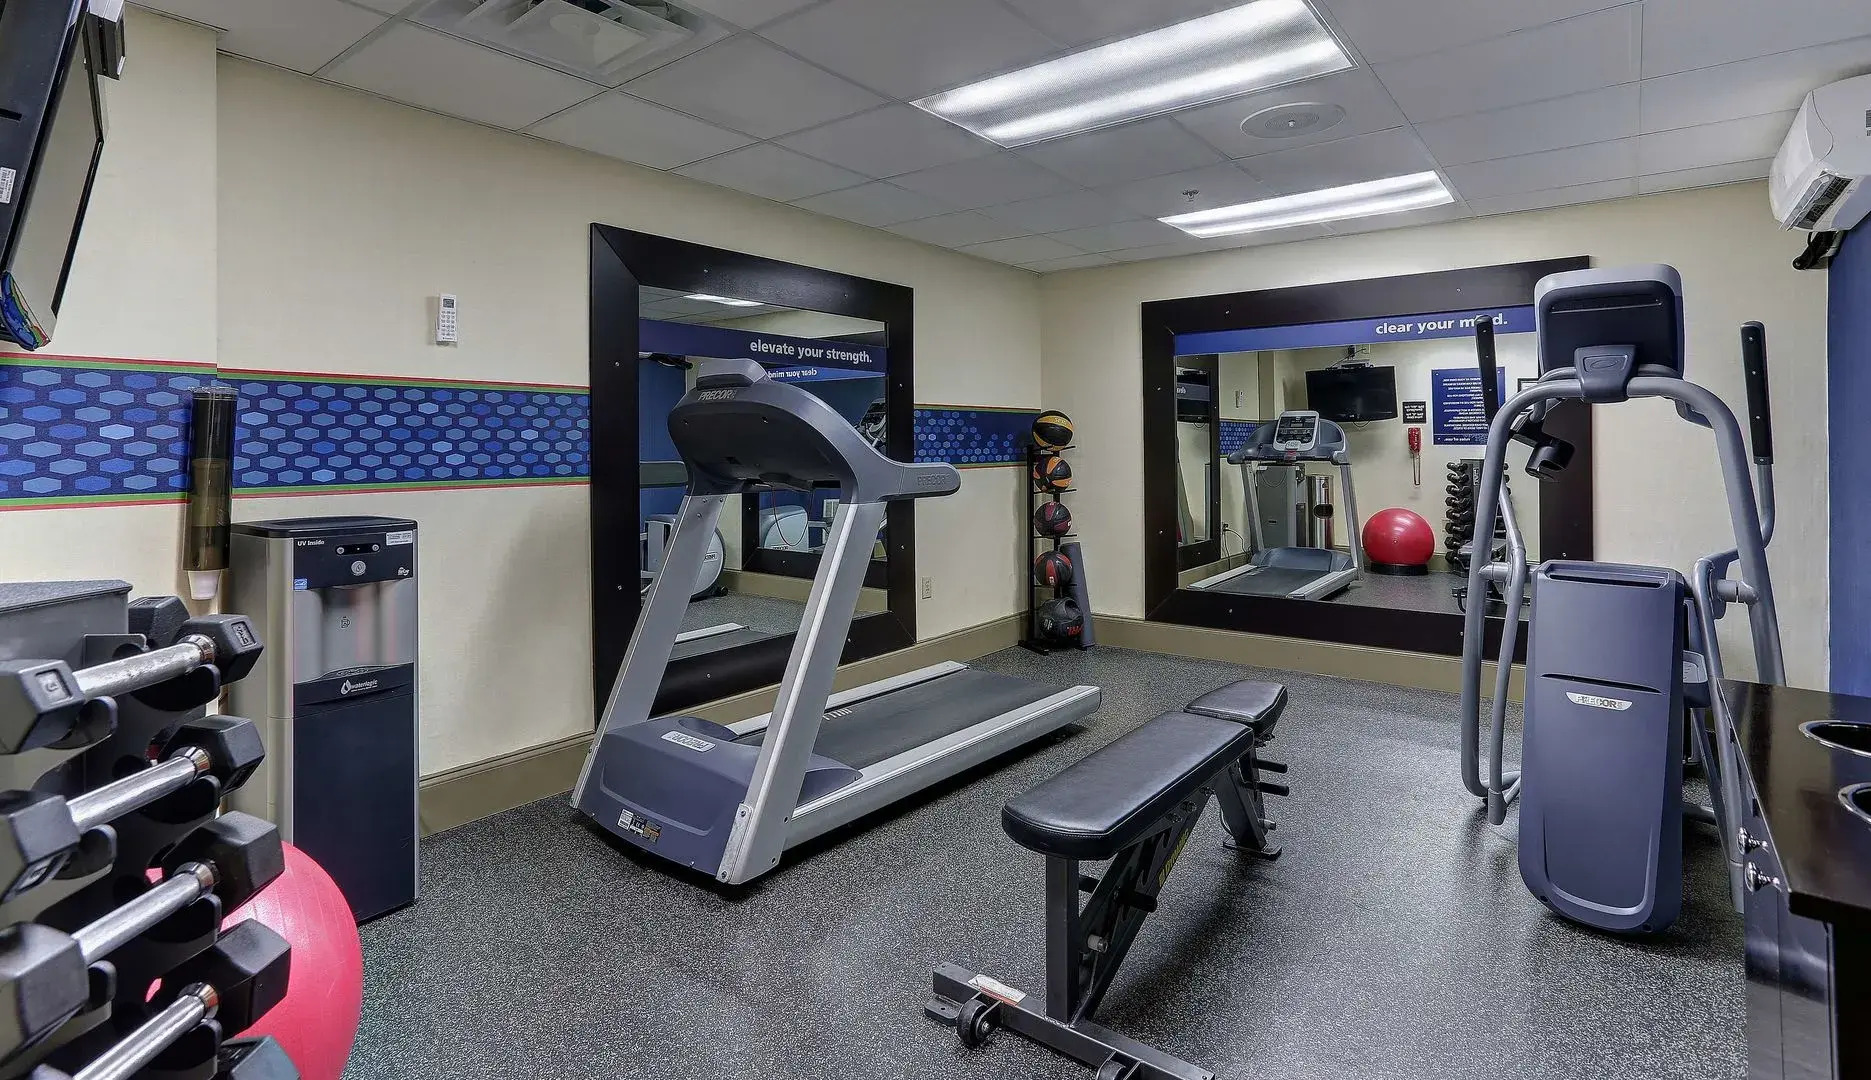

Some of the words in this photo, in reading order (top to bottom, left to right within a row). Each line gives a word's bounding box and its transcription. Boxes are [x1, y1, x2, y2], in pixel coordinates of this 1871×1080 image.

[1375, 322, 1413, 334] clear
[1417, 319, 1454, 335] your
[1459, 312, 1508, 328] md.
[749, 339, 795, 356] elevate
[797, 346, 824, 359] your
[826, 348, 873, 365] strength.
[697, 389, 733, 401] PRECOR
[1575, 695, 1618, 709] PRECOR
